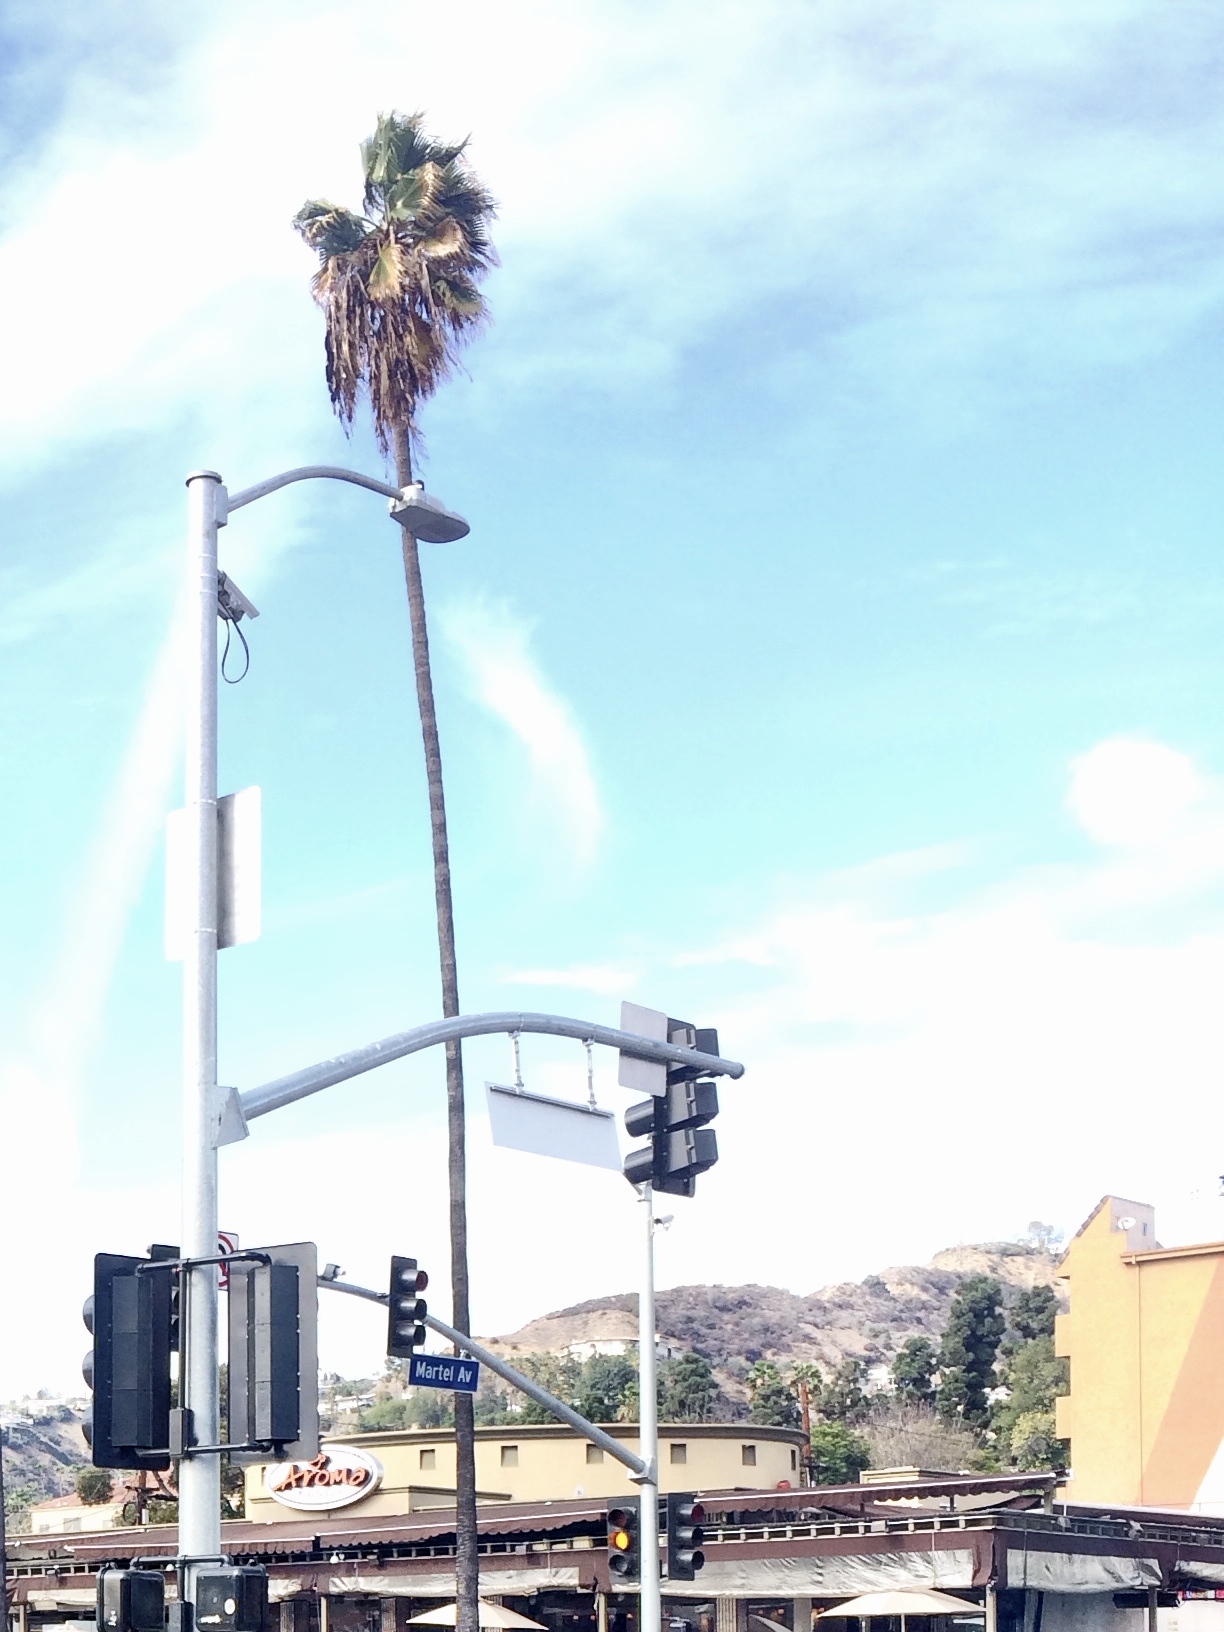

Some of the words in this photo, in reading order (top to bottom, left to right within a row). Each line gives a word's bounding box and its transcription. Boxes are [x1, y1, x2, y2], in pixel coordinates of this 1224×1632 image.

[416, 1360, 455, 1382] Martel
[457, 1366, 473, 1383] Av
[272, 1464, 369, 1493] Aroma
